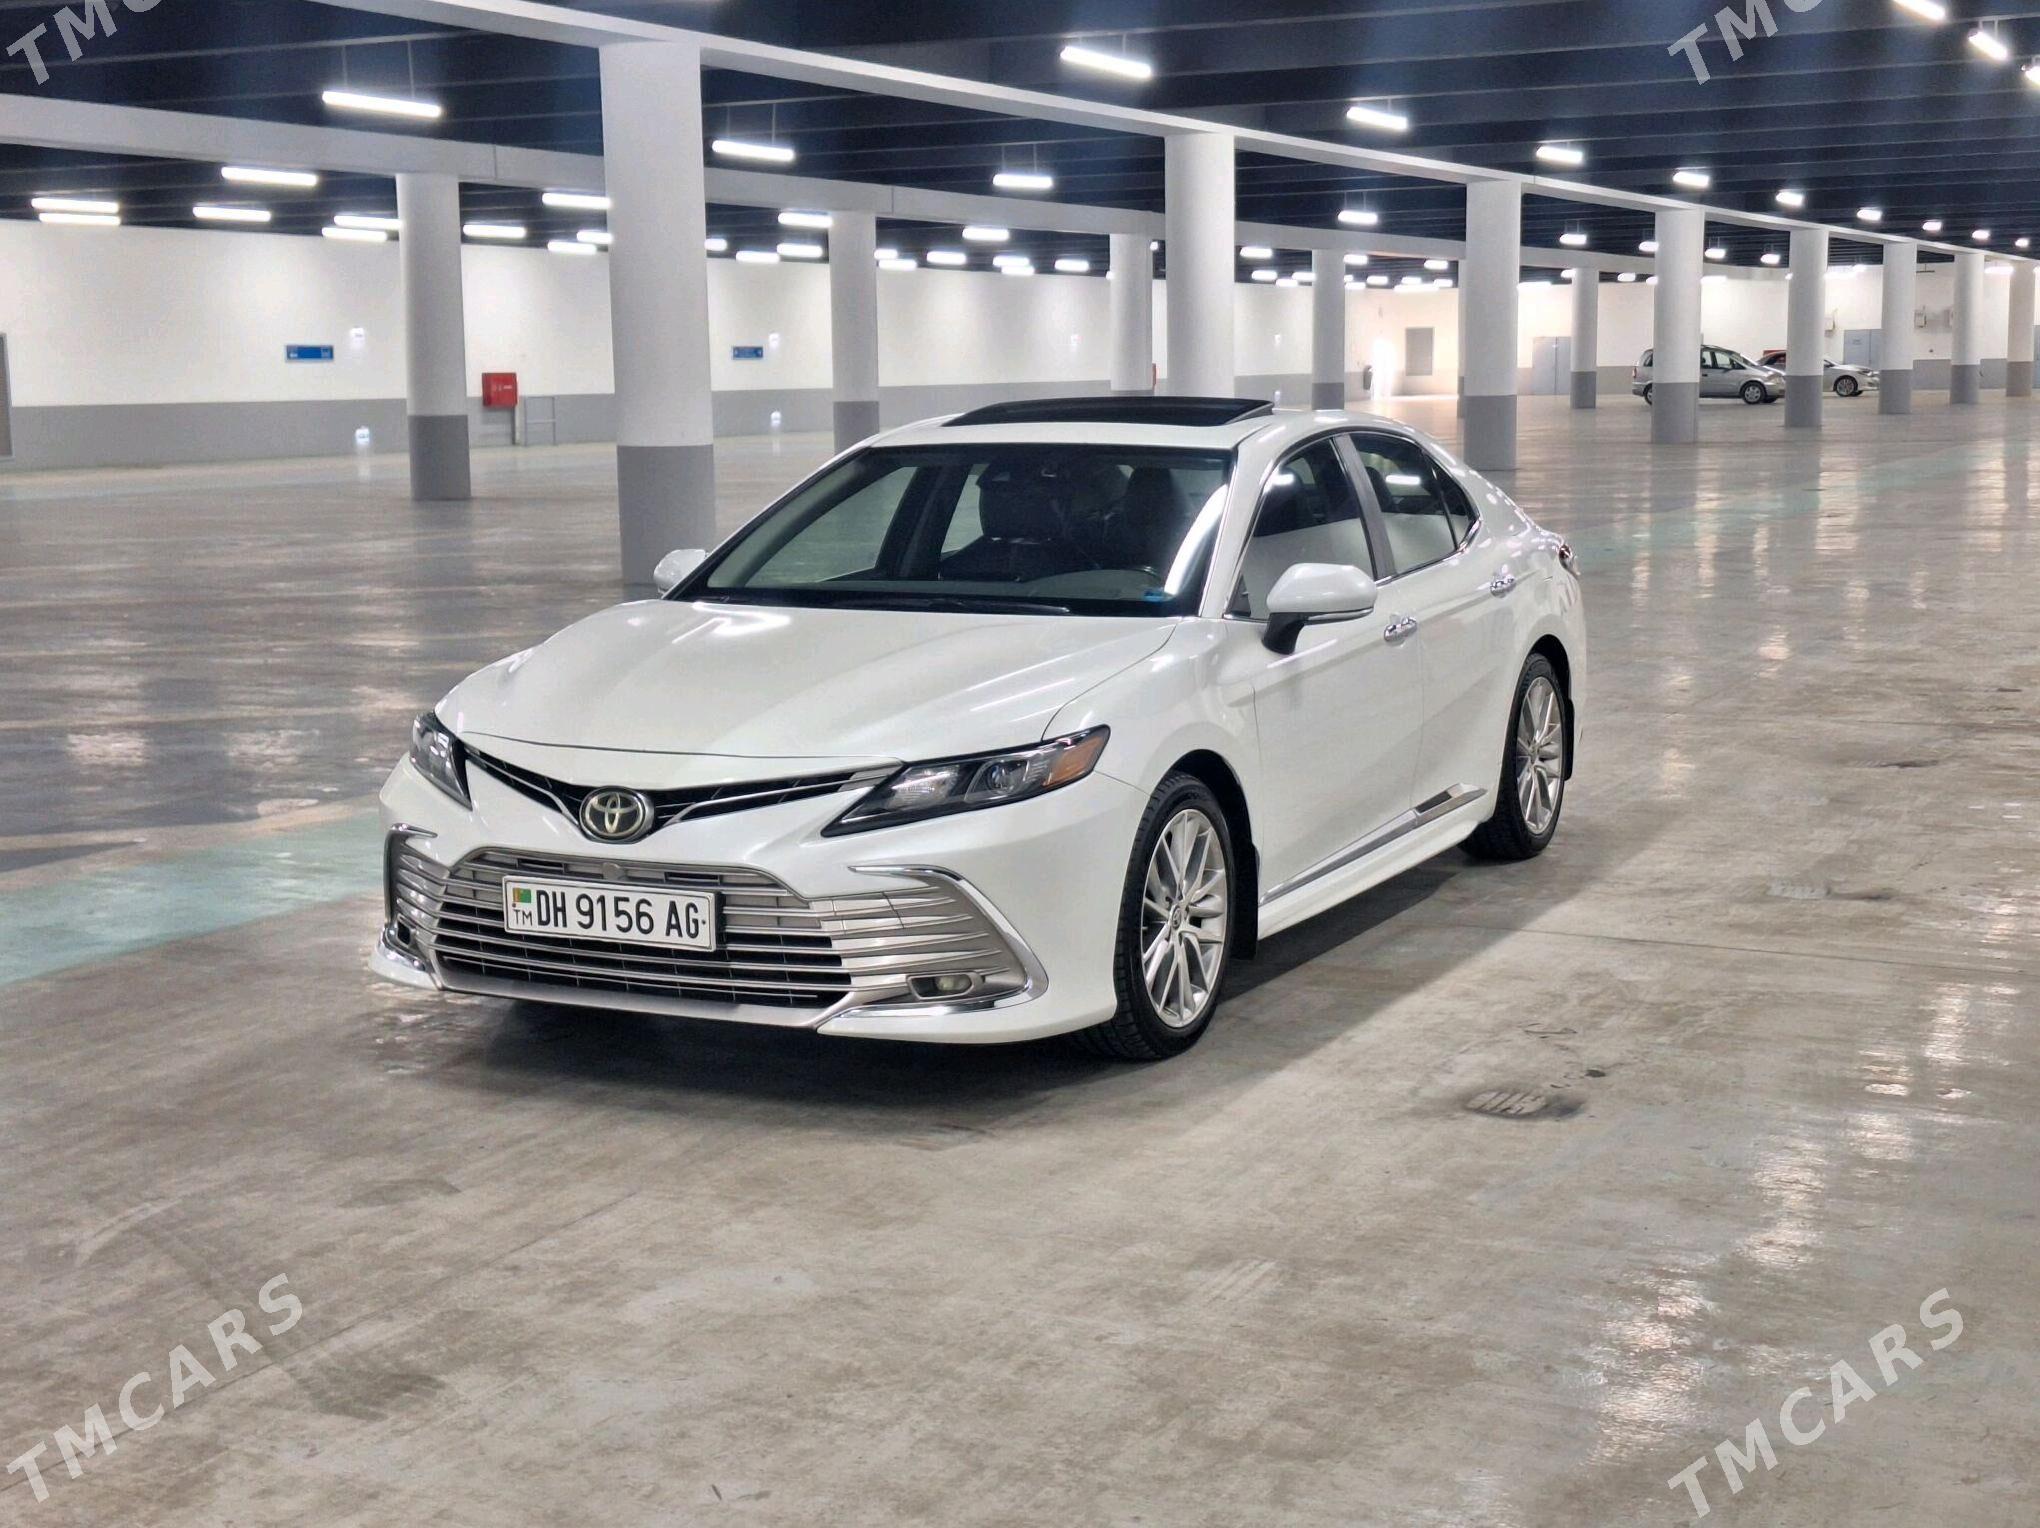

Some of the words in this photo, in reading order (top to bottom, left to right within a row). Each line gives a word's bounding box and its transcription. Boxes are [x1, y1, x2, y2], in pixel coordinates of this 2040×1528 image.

[514, 908, 533, 926] TM
[536, 889, 568, 928] DH
[576, 893, 655, 935] 9156
[665, 900, 700, 939] AG
